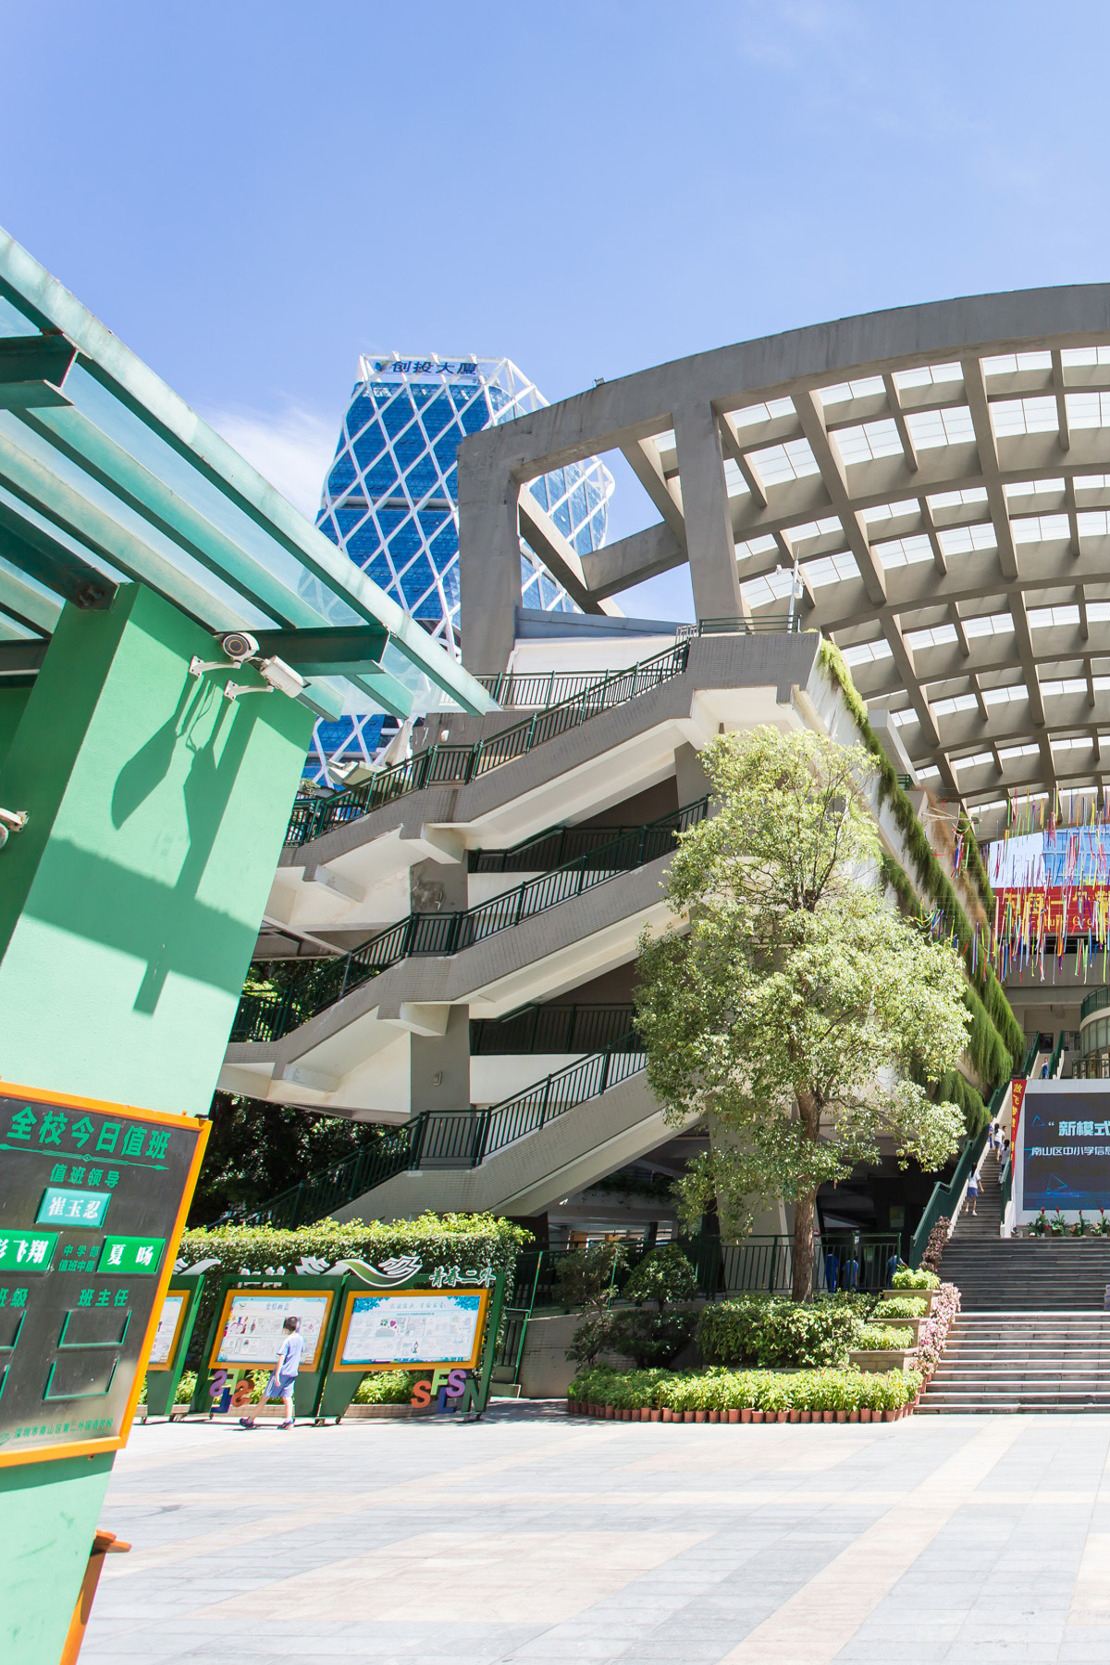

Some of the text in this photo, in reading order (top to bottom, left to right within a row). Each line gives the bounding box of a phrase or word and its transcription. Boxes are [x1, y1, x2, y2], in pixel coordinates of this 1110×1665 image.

[391, 360, 478, 375] 创投大厦
[6, 1106, 172, 1160] 全校今日值班
[50, 1163, 121, 1189] 值班领导
[77, 1288, 130, 1308] 班主任
